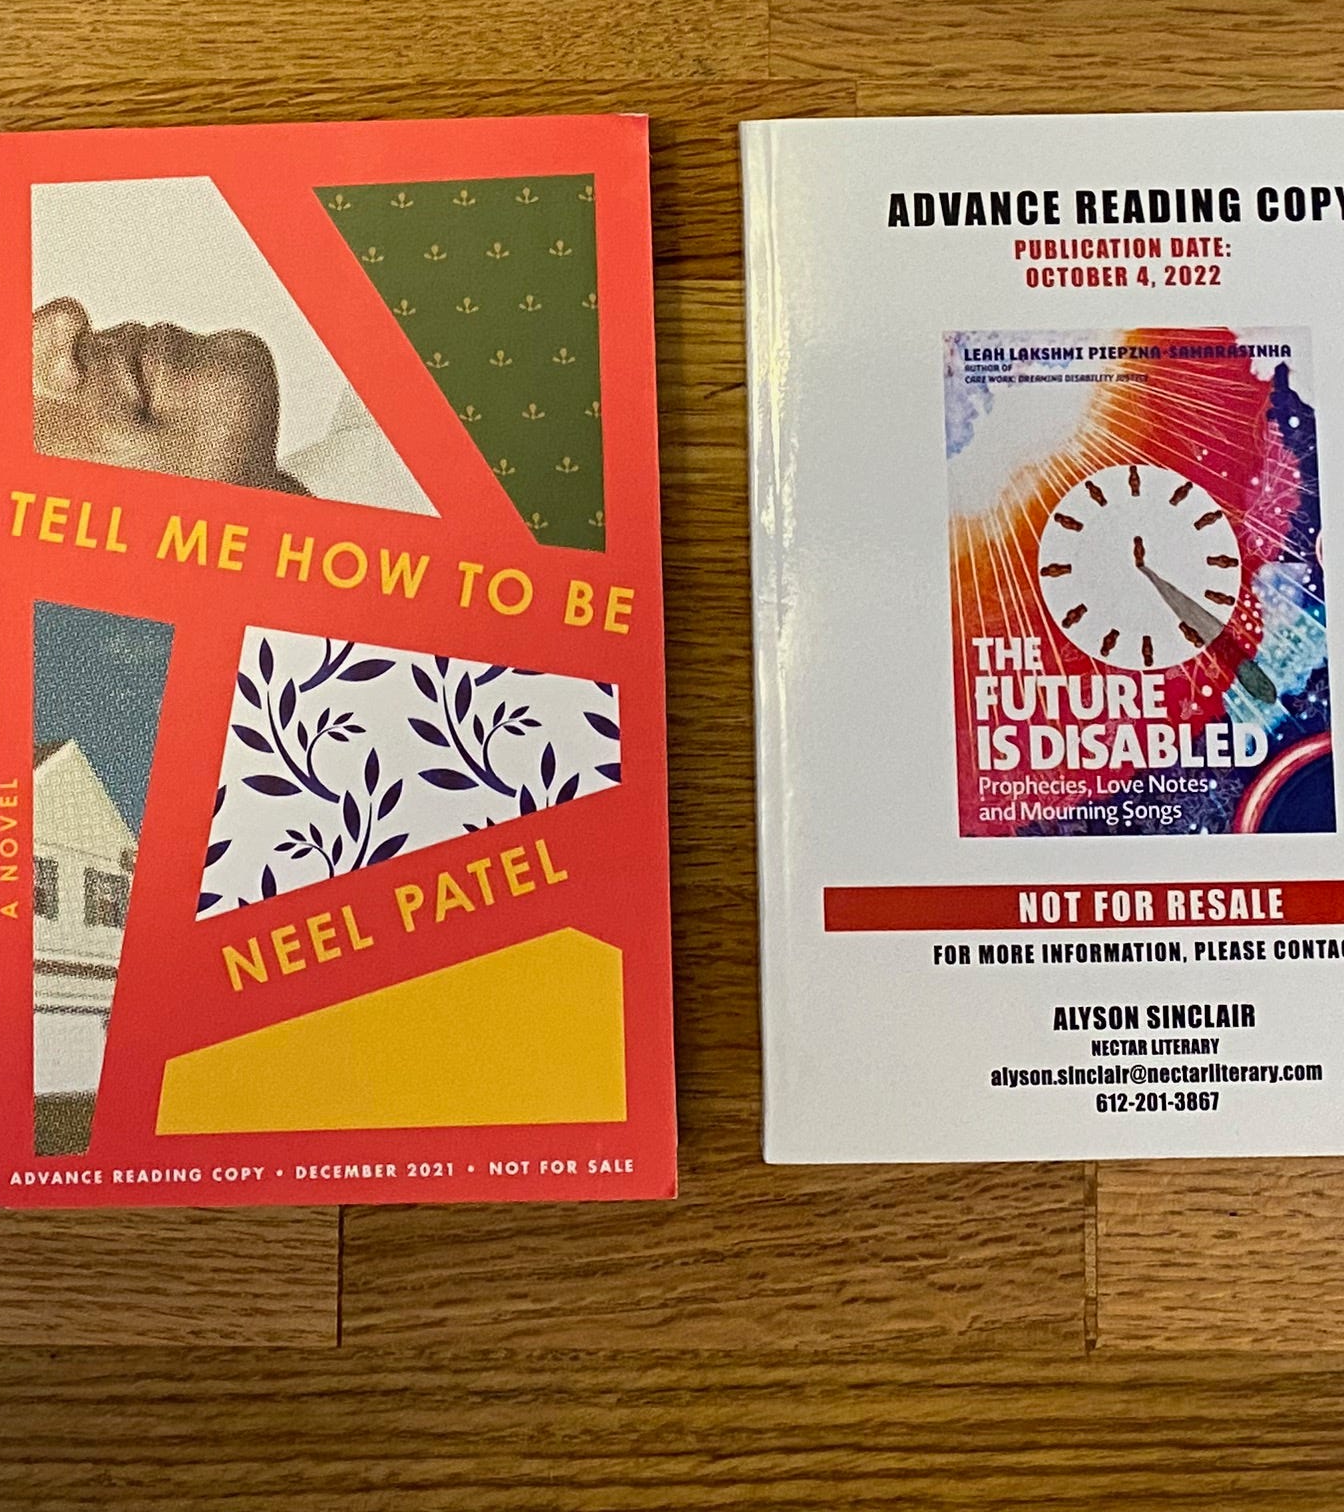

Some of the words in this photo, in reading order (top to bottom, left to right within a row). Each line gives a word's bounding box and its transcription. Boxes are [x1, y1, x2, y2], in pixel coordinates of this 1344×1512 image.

[888, 192, 1061, 227] ADVANCE
[1076, 188, 1242, 224] READING
[1015, 238, 1162, 260] PUBLICATION
[1170, 237, 1231, 258] DATE:
[1026, 266, 1127, 288] OCTOBER
[1137, 267, 1156, 289] 4,
[1164, 265, 1221, 286] 2022
[964, 348, 1005, 361] LEAH
[1010, 347, 1083, 360] LAKSHMI
[1089, 344, 1291, 360] PIEPZNA-SAMARASINHA
[965, 365, 1000, 373] AUTHOR
[1003, 364, 1012, 372] OF
[10, 490, 129, 554] TELL
[156, 518, 250, 572] ME
[275, 533, 430, 599] HOW
[458, 560, 534, 617] TO
[563, 581, 634, 635] BE
[972, 637, 1042, 672] THE
[975, 674, 1168, 721] FUTURE
[979, 725, 1021, 770] IS
[1029, 722, 1268, 769] DISABLED
[979, 775, 1093, 799] Prophecies,
[1097, 776, 1144, 793] Love
[1149, 774, 1209, 793] Notes
[979, 804, 1015, 821] and
[1020, 802, 1117, 825] Mourning
[1123, 801, 1182, 824] Songs
[0, 778, 18, 884] NOVEL
[0, 899, 18, 919] A
[222, 910, 375, 991] NEEL
[395, 838, 568, 932] PATEL
[1019, 891, 1081, 924] NOT
[1095, 890, 1153, 922] FOR
[1168, 888, 1284, 921] RESALE
[933, 945, 971, 965] FOR
[978, 944, 1035, 964] MORE
[1042, 942, 1187, 964] INFORMATION,
[1195, 940, 1266, 961] PLEASE
[1054, 1007, 1140, 1031] ALYSON
[1147, 1005, 1255, 1028] SINCLAIR
[1091, 1039, 1148, 1056] NECTAR
[1152, 1038, 1219, 1054] LITERARY
[991, 1062, 1322, 1087] alyson.sinclair@nectarliterary.com
[1096, 1093, 1219, 1112] 612-201-3867
[10, 1169, 103, 1185] ADVANCE
[113, 1167, 201, 1184] READING
[212, 1166, 264, 1182] COPY
[295, 1164, 399, 1180] DECEMBER
[407, 1162, 454, 1178] 2021
[489, 1160, 536, 1176] NOT
[540, 1160, 578, 1175] FOR
[588, 1159, 634, 1174] SALE
